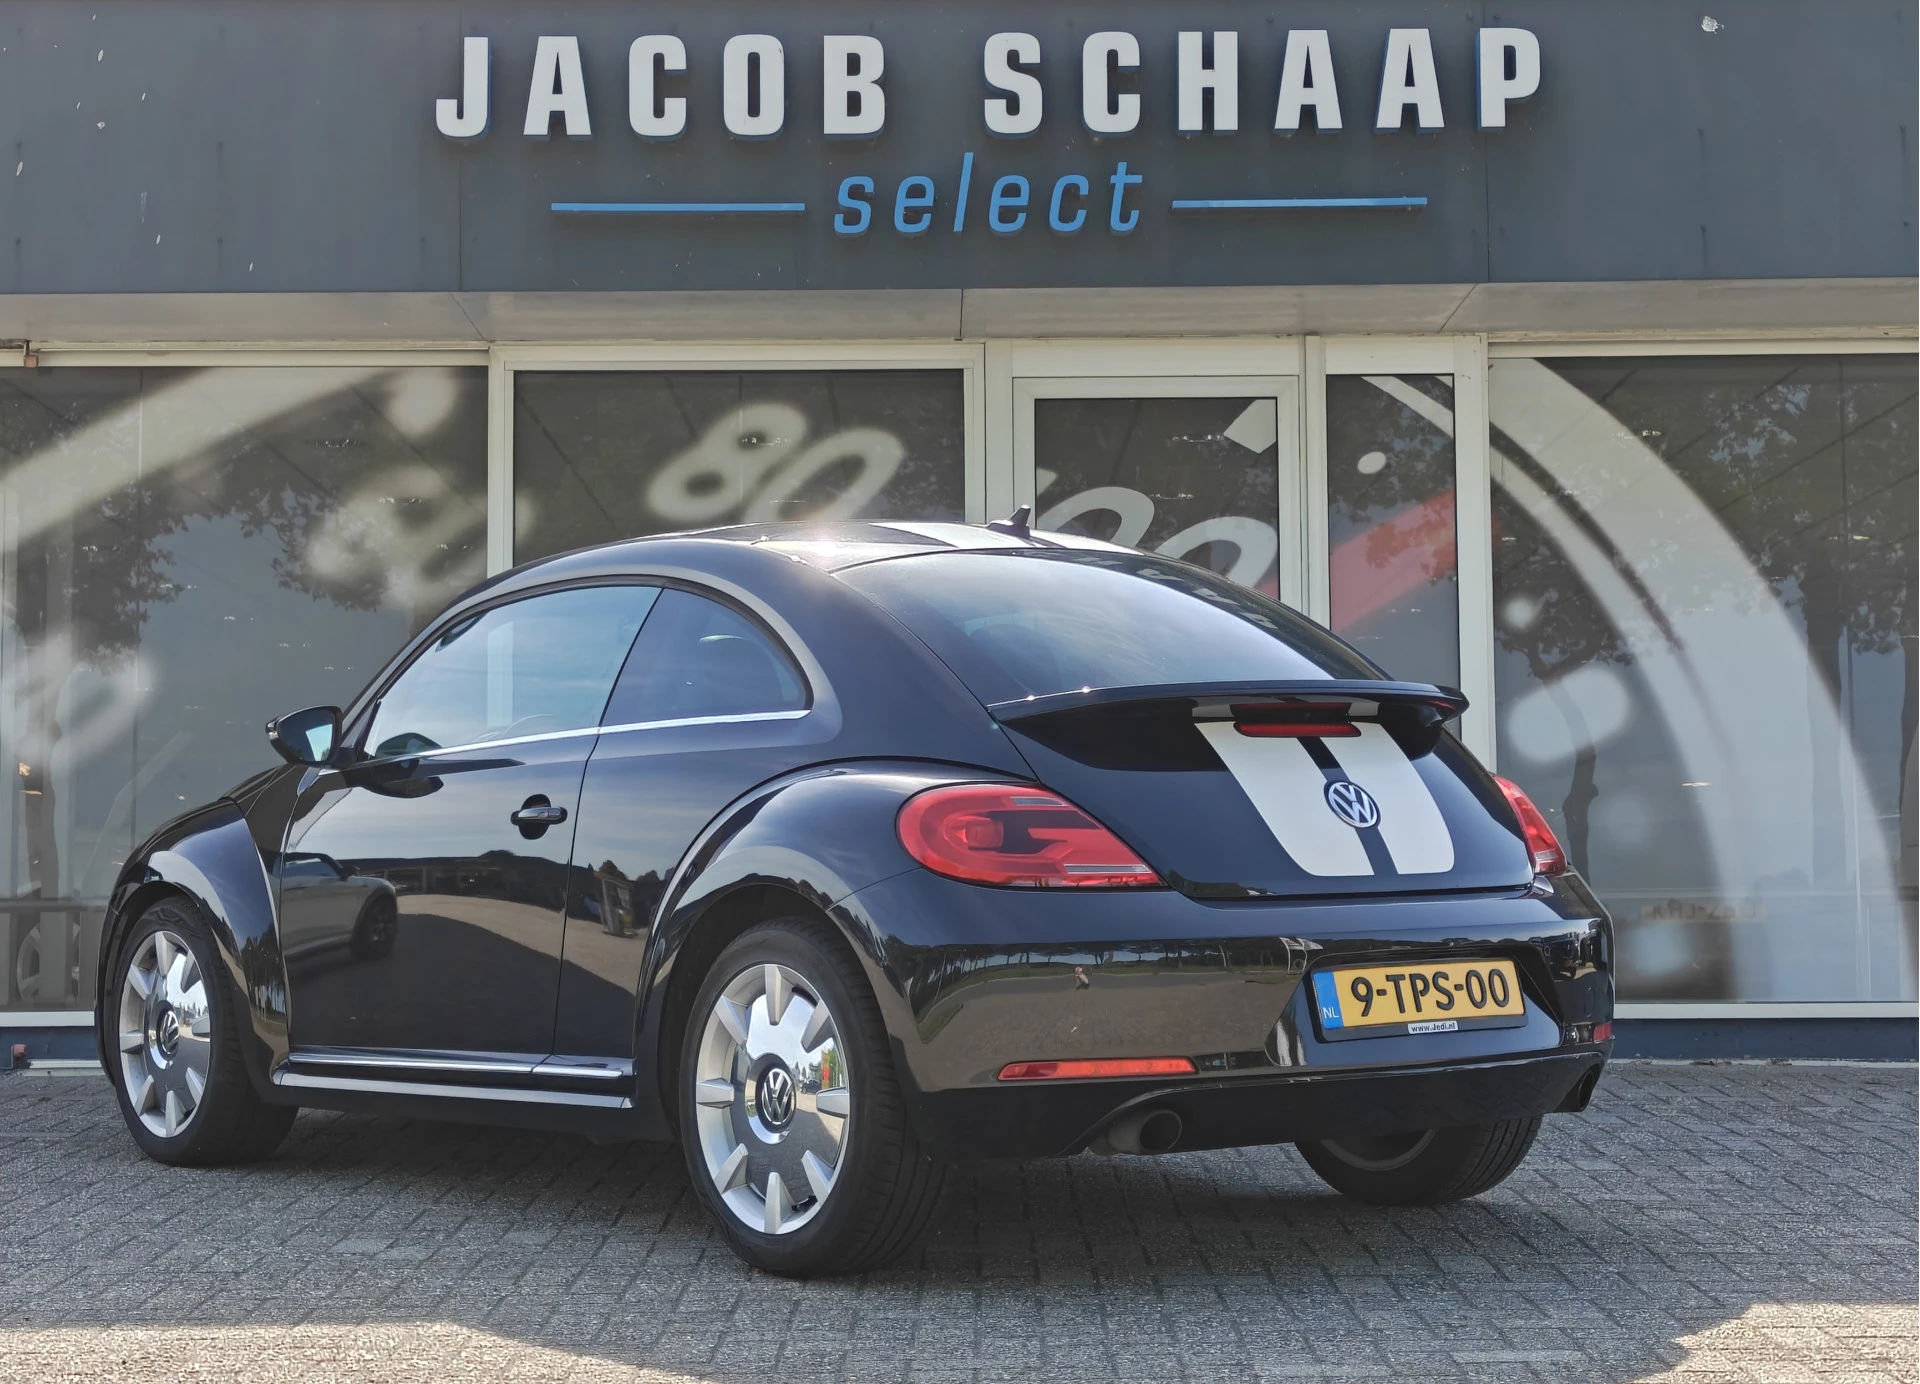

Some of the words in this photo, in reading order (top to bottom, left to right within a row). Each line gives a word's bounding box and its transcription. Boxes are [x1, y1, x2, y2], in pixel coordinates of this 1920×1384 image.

[436, 33, 887, 139] JACOB
[983, 27, 1541, 136] SCHAAP
[833, 151, 1143, 235] select
[1322, 1006, 1340, 1019] NL
[1350, 968, 1510, 1018] 9-TPS-00
